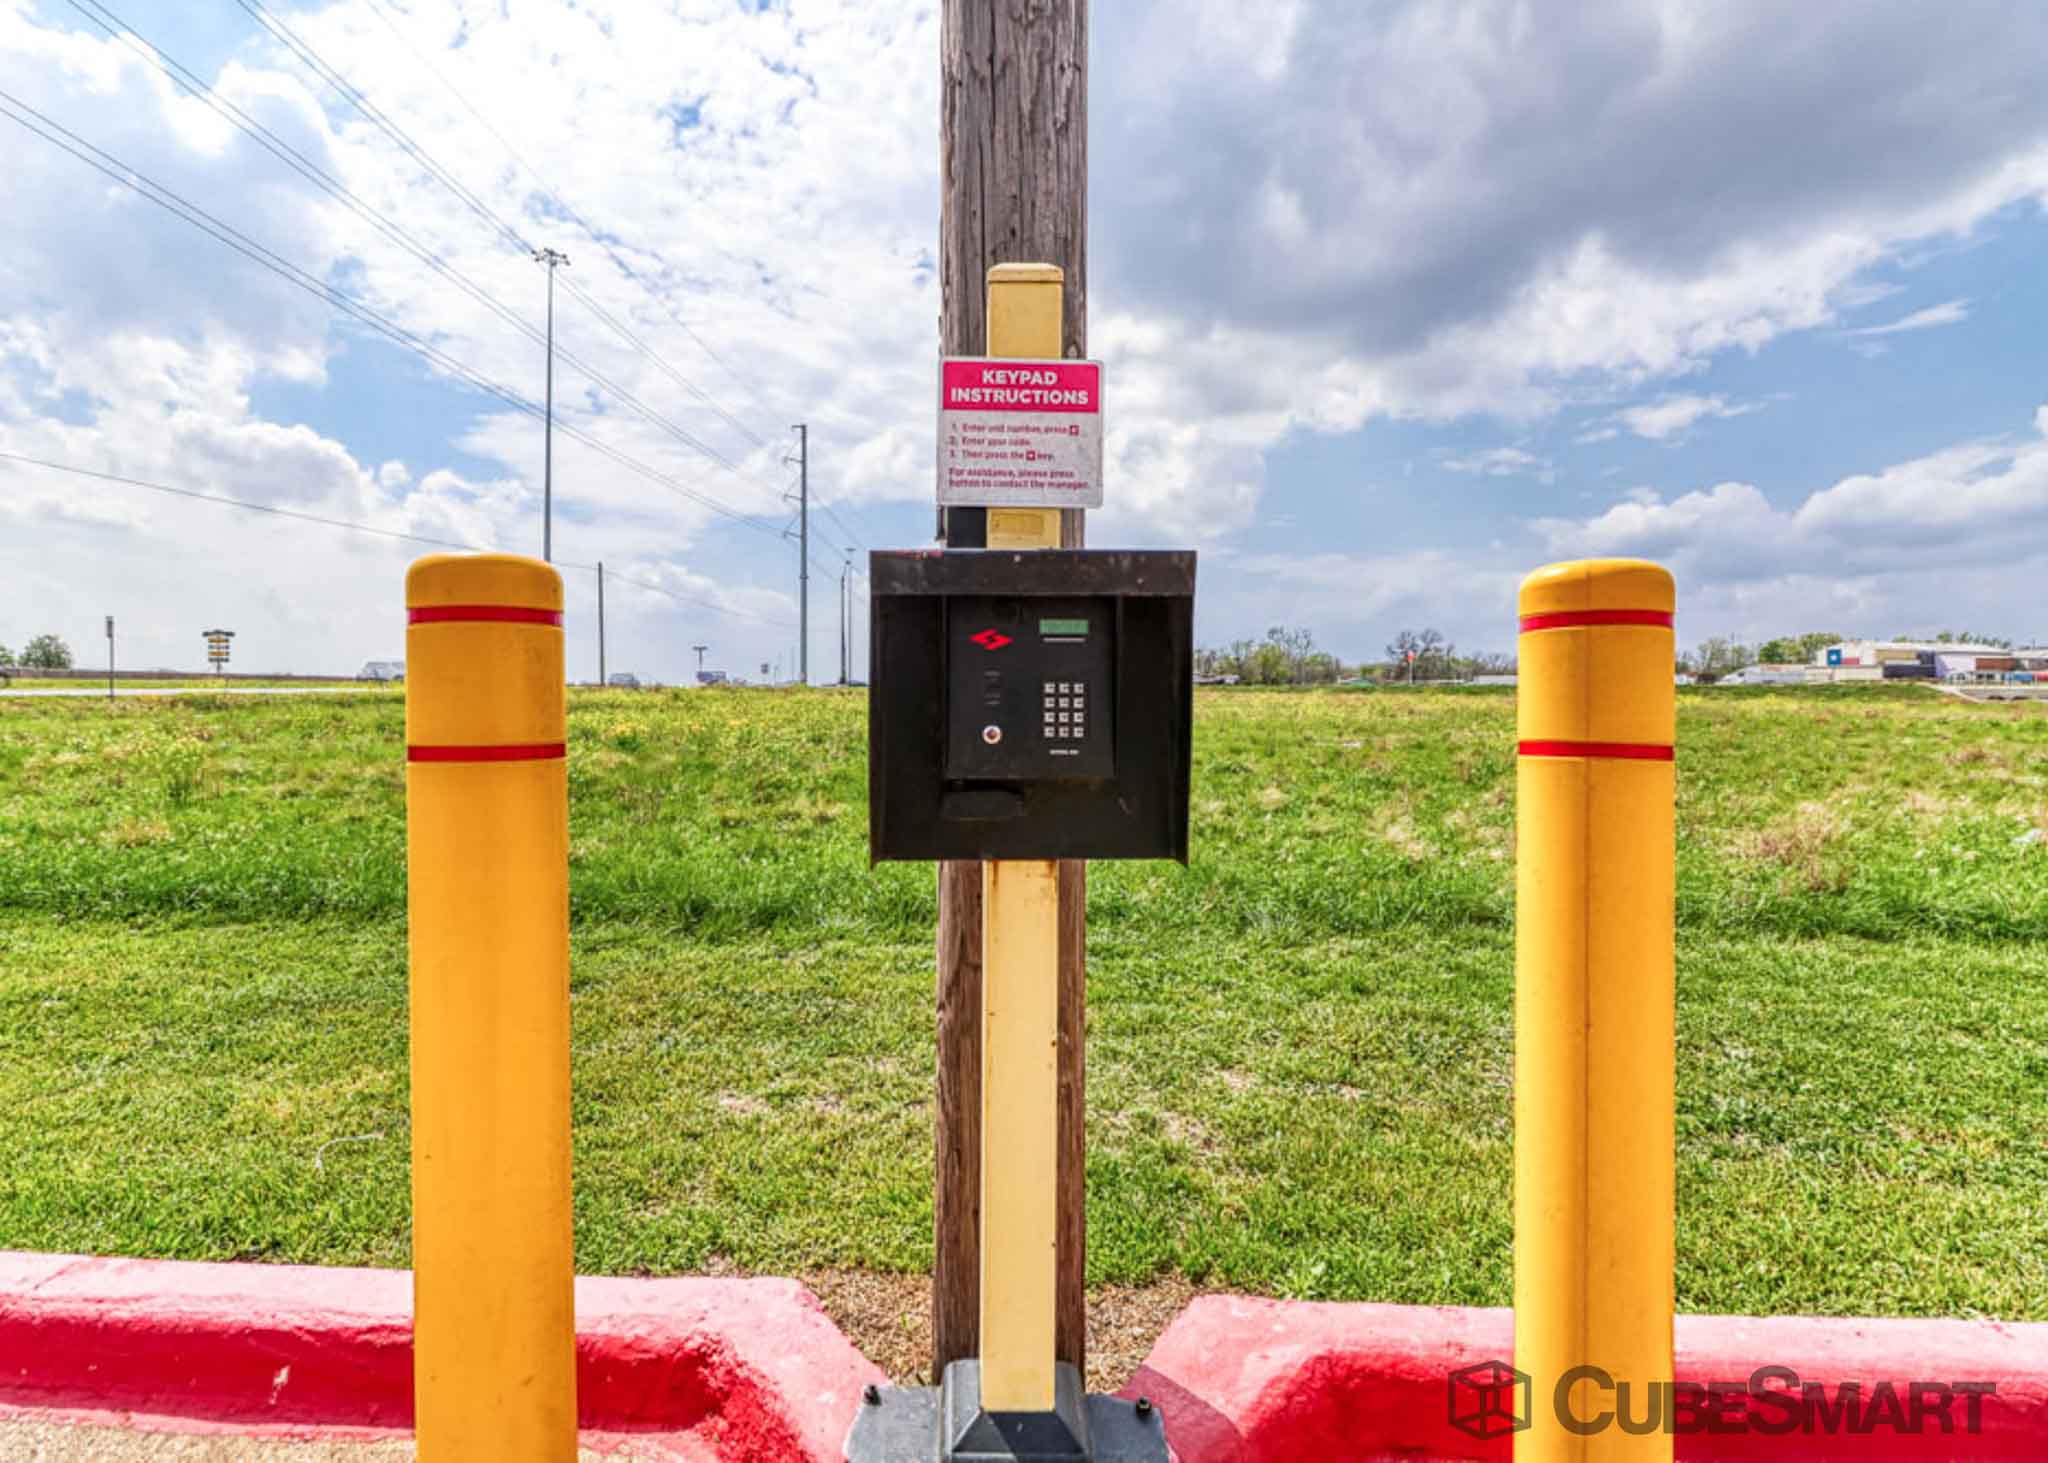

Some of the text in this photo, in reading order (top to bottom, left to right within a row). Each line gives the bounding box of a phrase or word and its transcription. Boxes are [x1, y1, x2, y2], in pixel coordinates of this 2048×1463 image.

[982, 370, 1058, 385] KEYPAD
[951, 387, 1089, 405] INSTRUCTIONS
[962, 423, 985, 433] Enter
[962, 436, 985, 446] Enter
[962, 449, 983, 459] Then
[985, 451, 1007, 461] press
[1010, 450, 1024, 459] the
[949, 467, 965, 477] For
[1018, 469, 1048, 479] please
[1050, 470, 1074, 480] press
[949, 478, 980, 488] button
[982, 478, 992, 488] to
[993, 479, 1029, 488] contact
[1030, 480, 1045, 490] the
